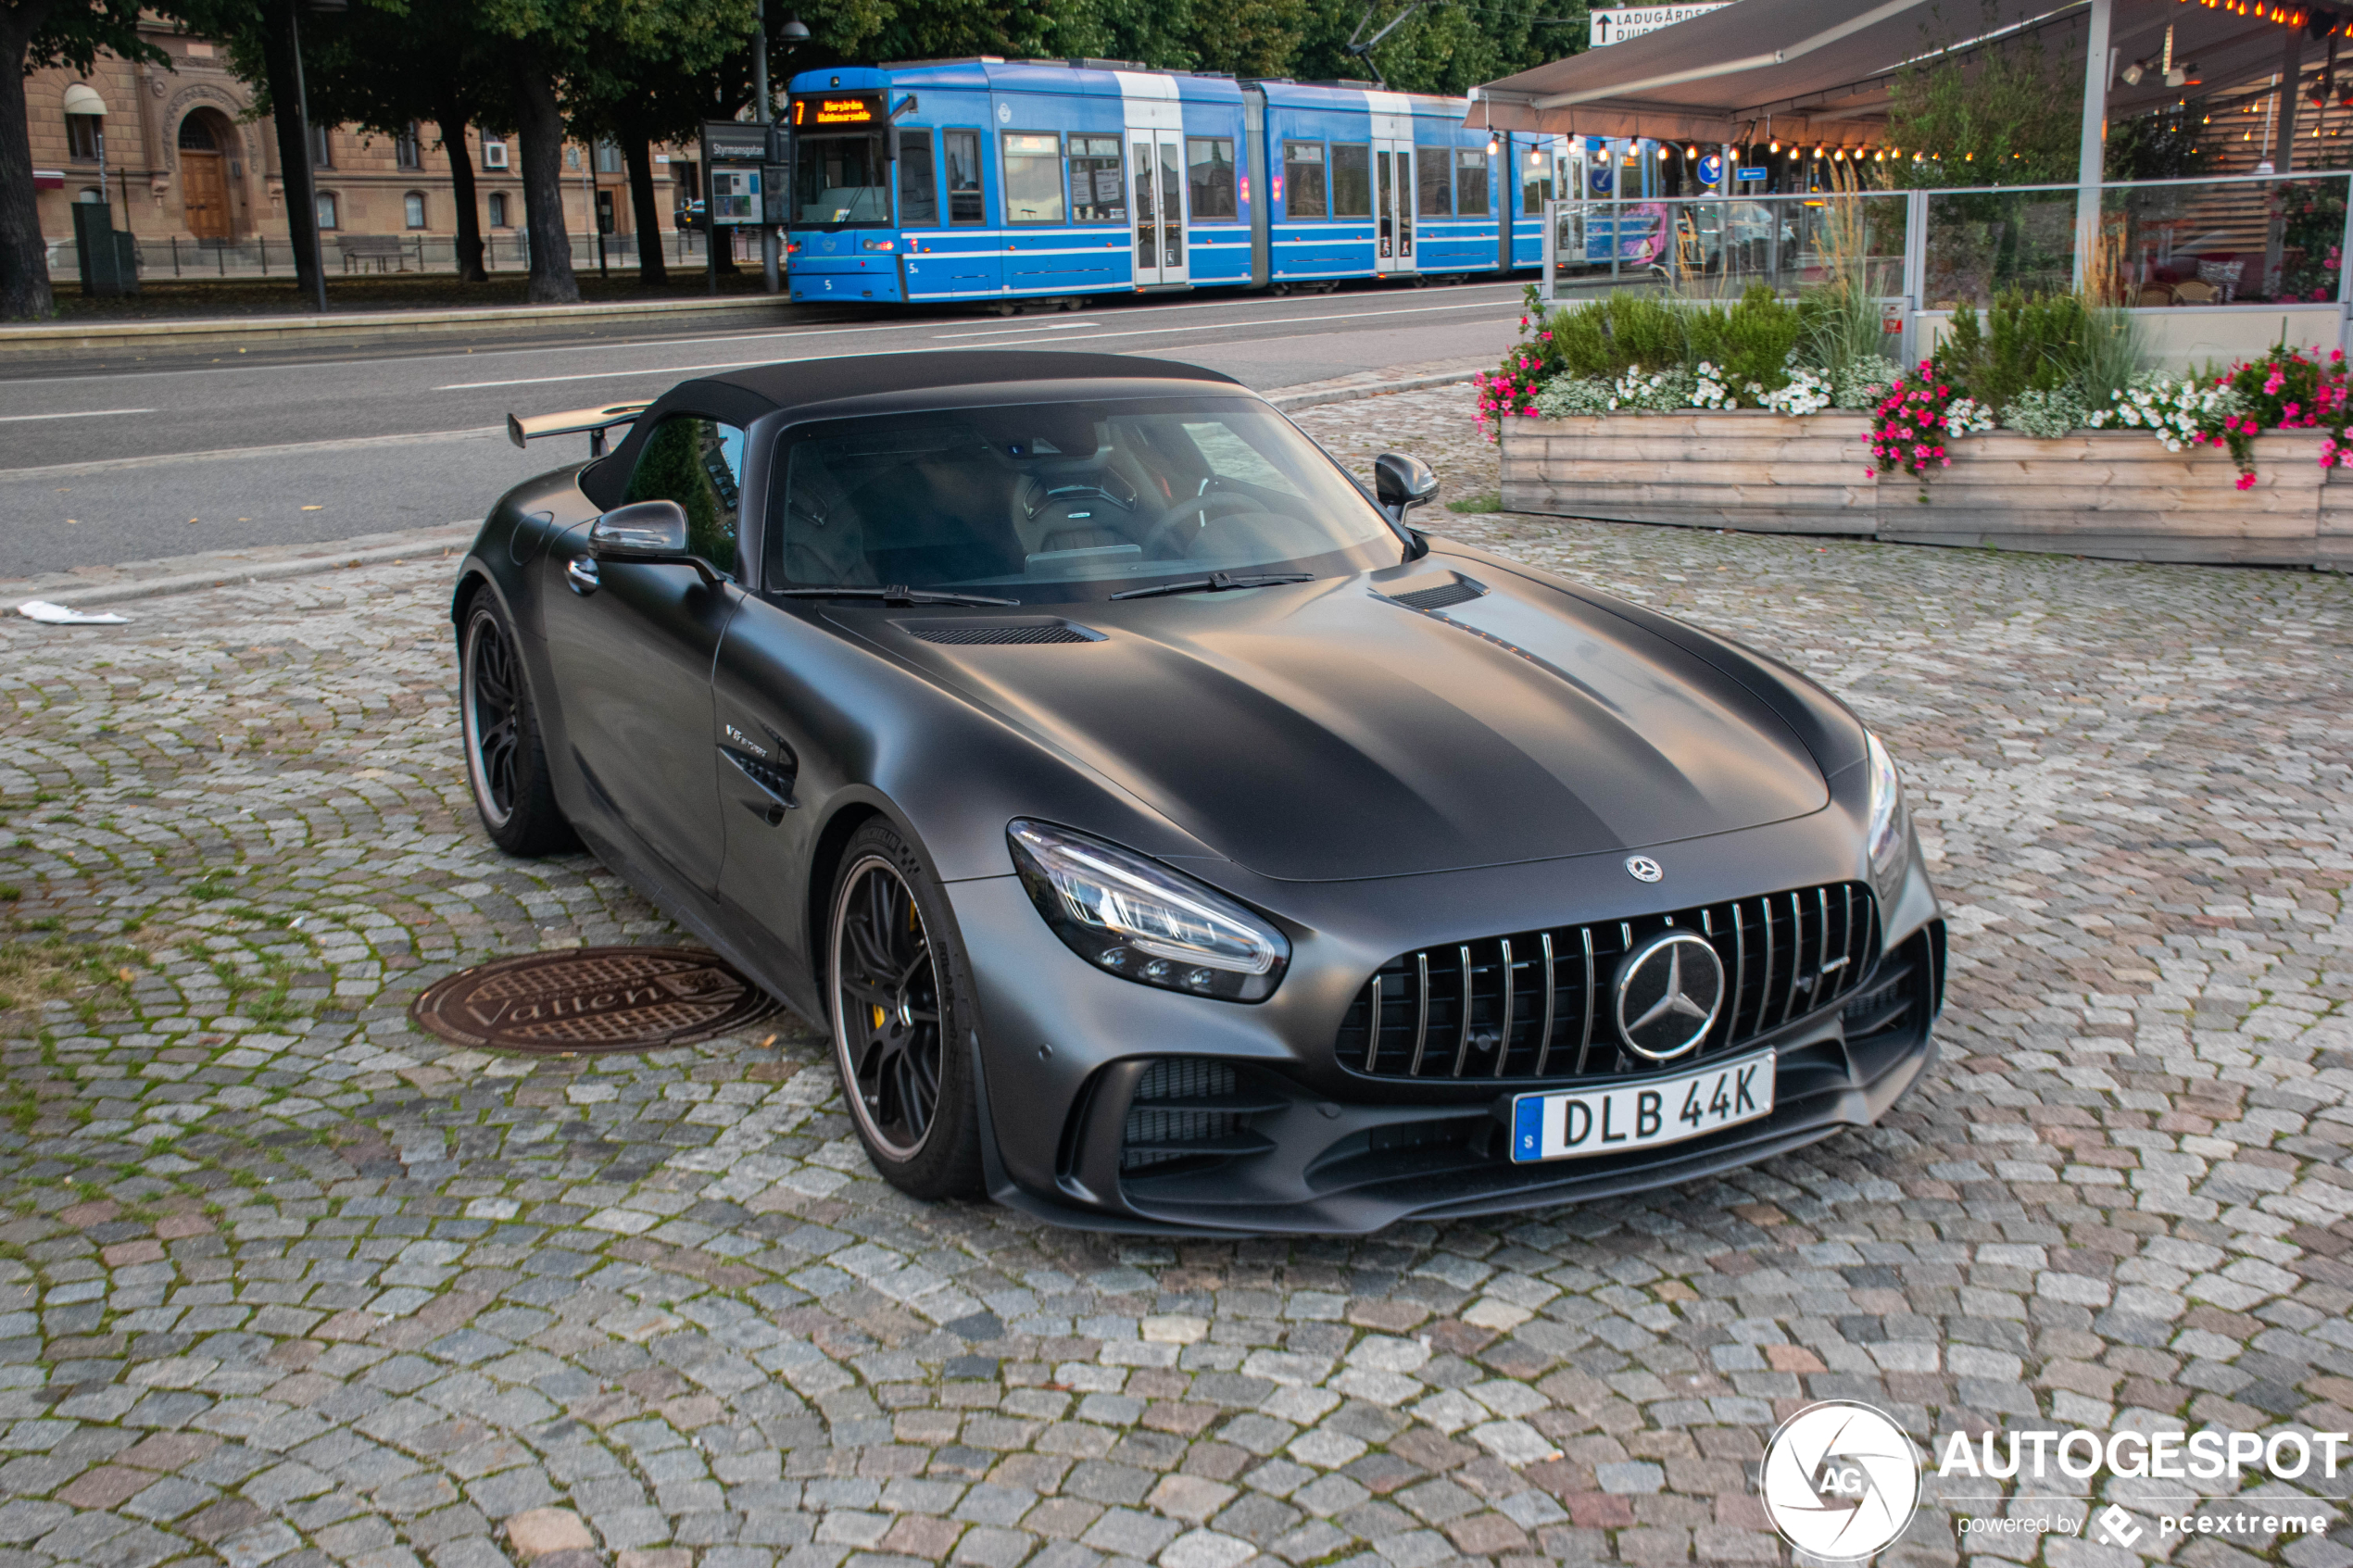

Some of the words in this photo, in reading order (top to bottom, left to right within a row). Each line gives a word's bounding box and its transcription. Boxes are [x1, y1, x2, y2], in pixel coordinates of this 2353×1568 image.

[796, 102, 804, 125] 7
[712, 143, 765, 157] Styrmansgatan
[824, 280, 833, 291] 5
[1564, 1089, 1662, 1148] DLB
[1680, 1063, 1757, 1127] 44K
[1524, 1135, 1534, 1149] S
